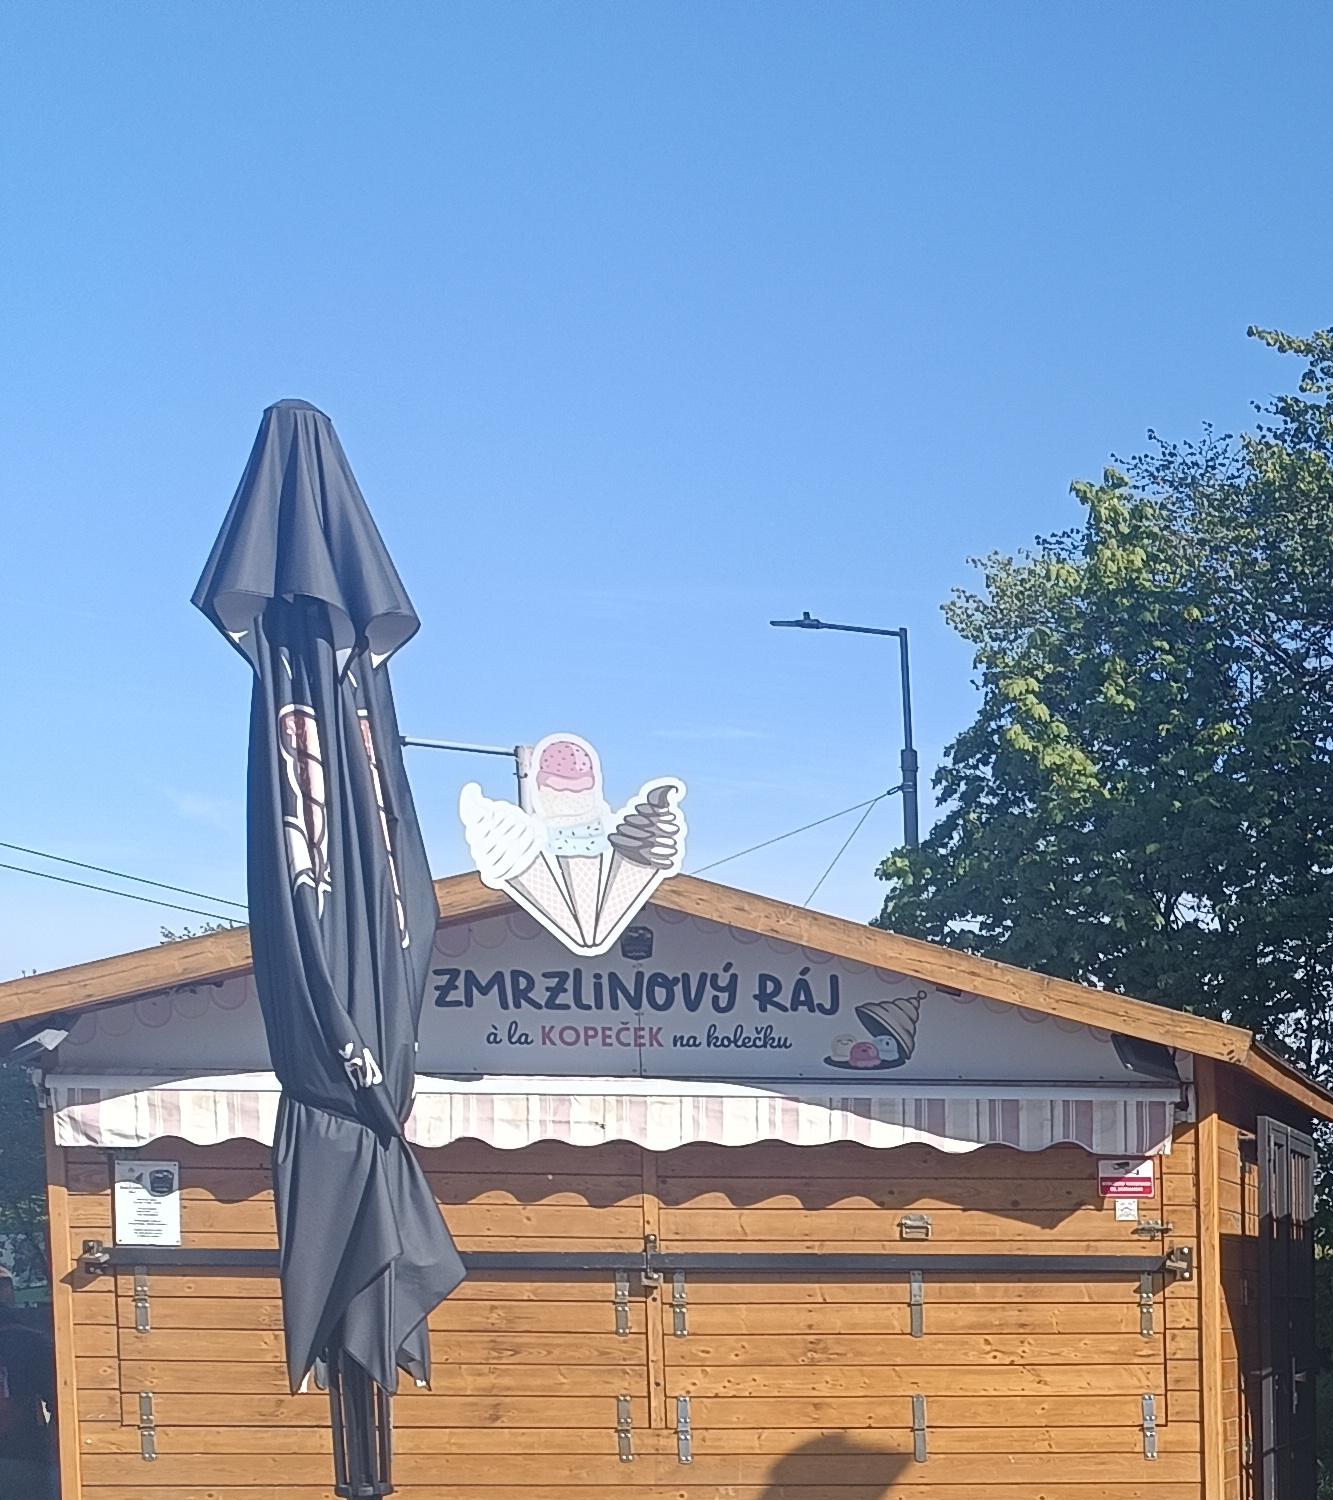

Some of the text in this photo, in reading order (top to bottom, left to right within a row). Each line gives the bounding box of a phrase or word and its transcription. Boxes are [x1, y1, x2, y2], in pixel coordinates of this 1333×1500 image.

[432, 961, 840, 1016] ZMRZLINOVÝ RÁJ
[507, 1020, 534, 1046] la
[540, 1021, 664, 1049] KOPEČEK
[672, 1031, 702, 1049] na
[706, 1025, 793, 1050] kolečku
